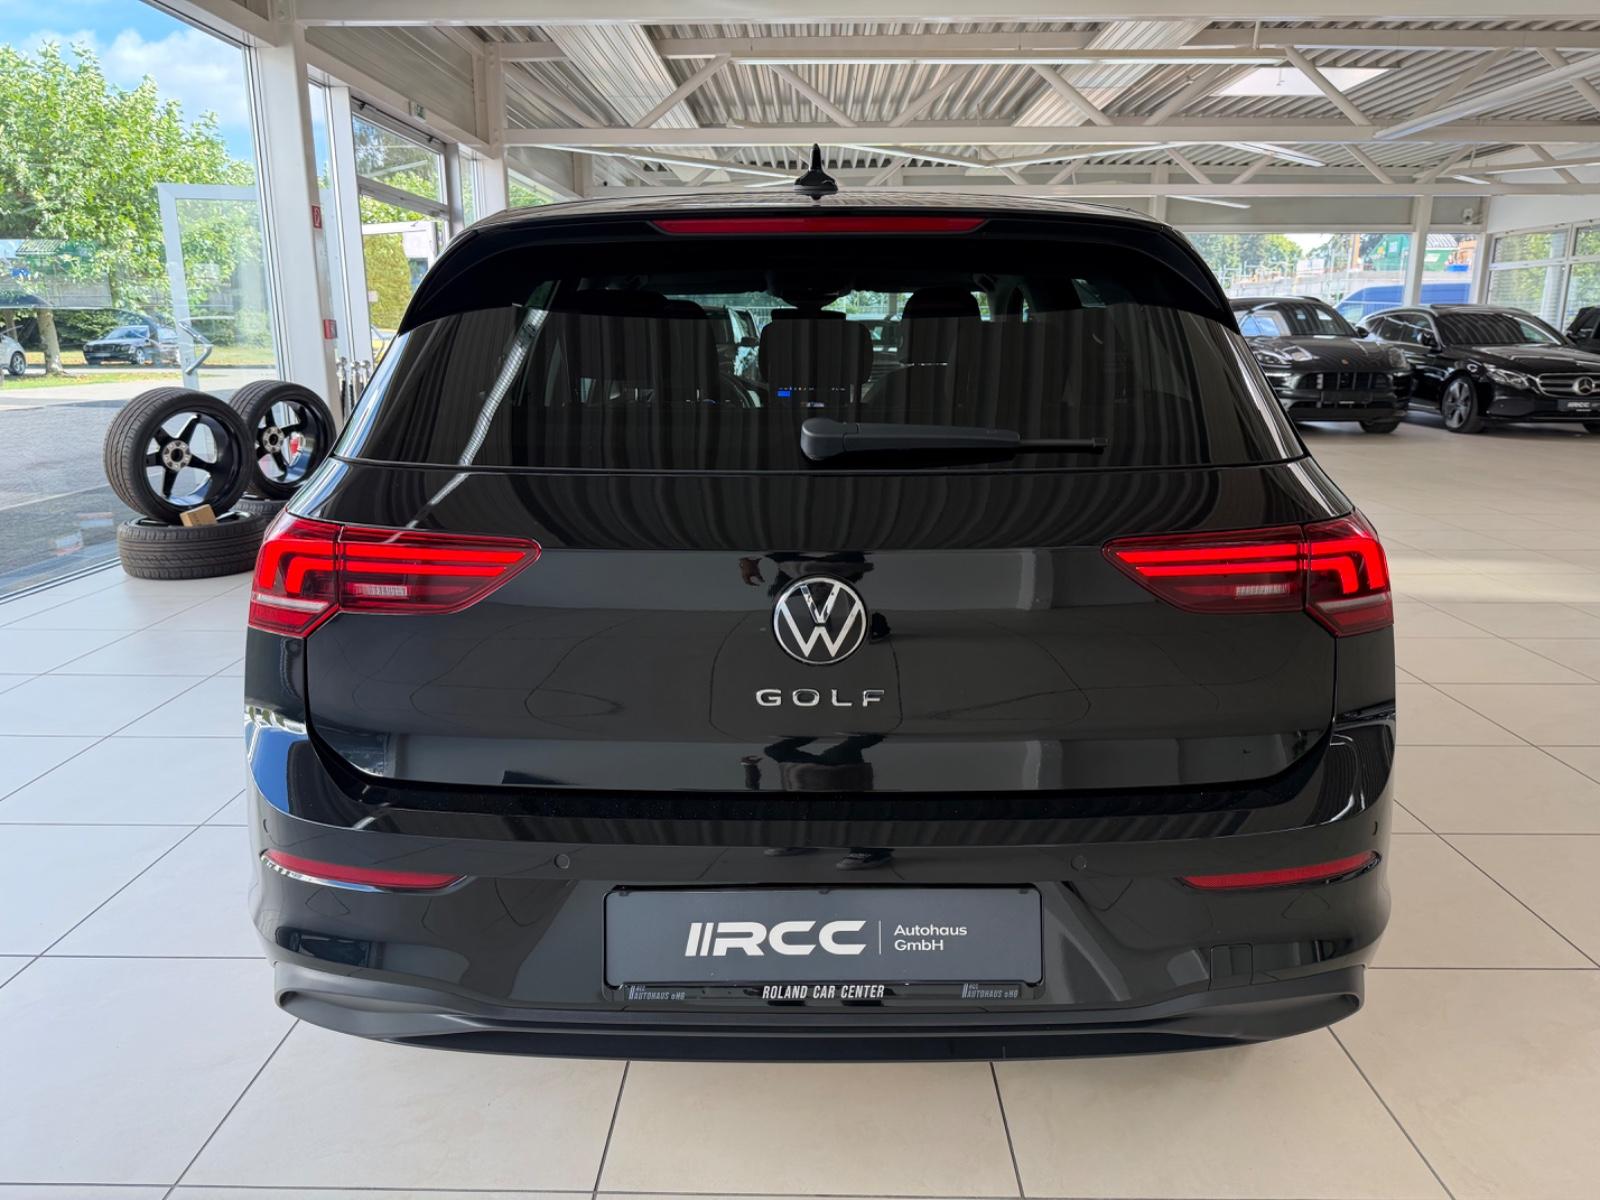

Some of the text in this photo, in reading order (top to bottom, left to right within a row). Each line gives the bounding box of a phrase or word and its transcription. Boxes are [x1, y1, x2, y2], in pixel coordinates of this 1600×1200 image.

[756, 688, 885, 707] GOLF
[893, 924, 968, 937] Autohaus
[894, 939, 944, 951] GmbH
[634, 991, 670, 1000] AUTOHAUS
[762, 985, 885, 999] ROLAND CAR CENTER
